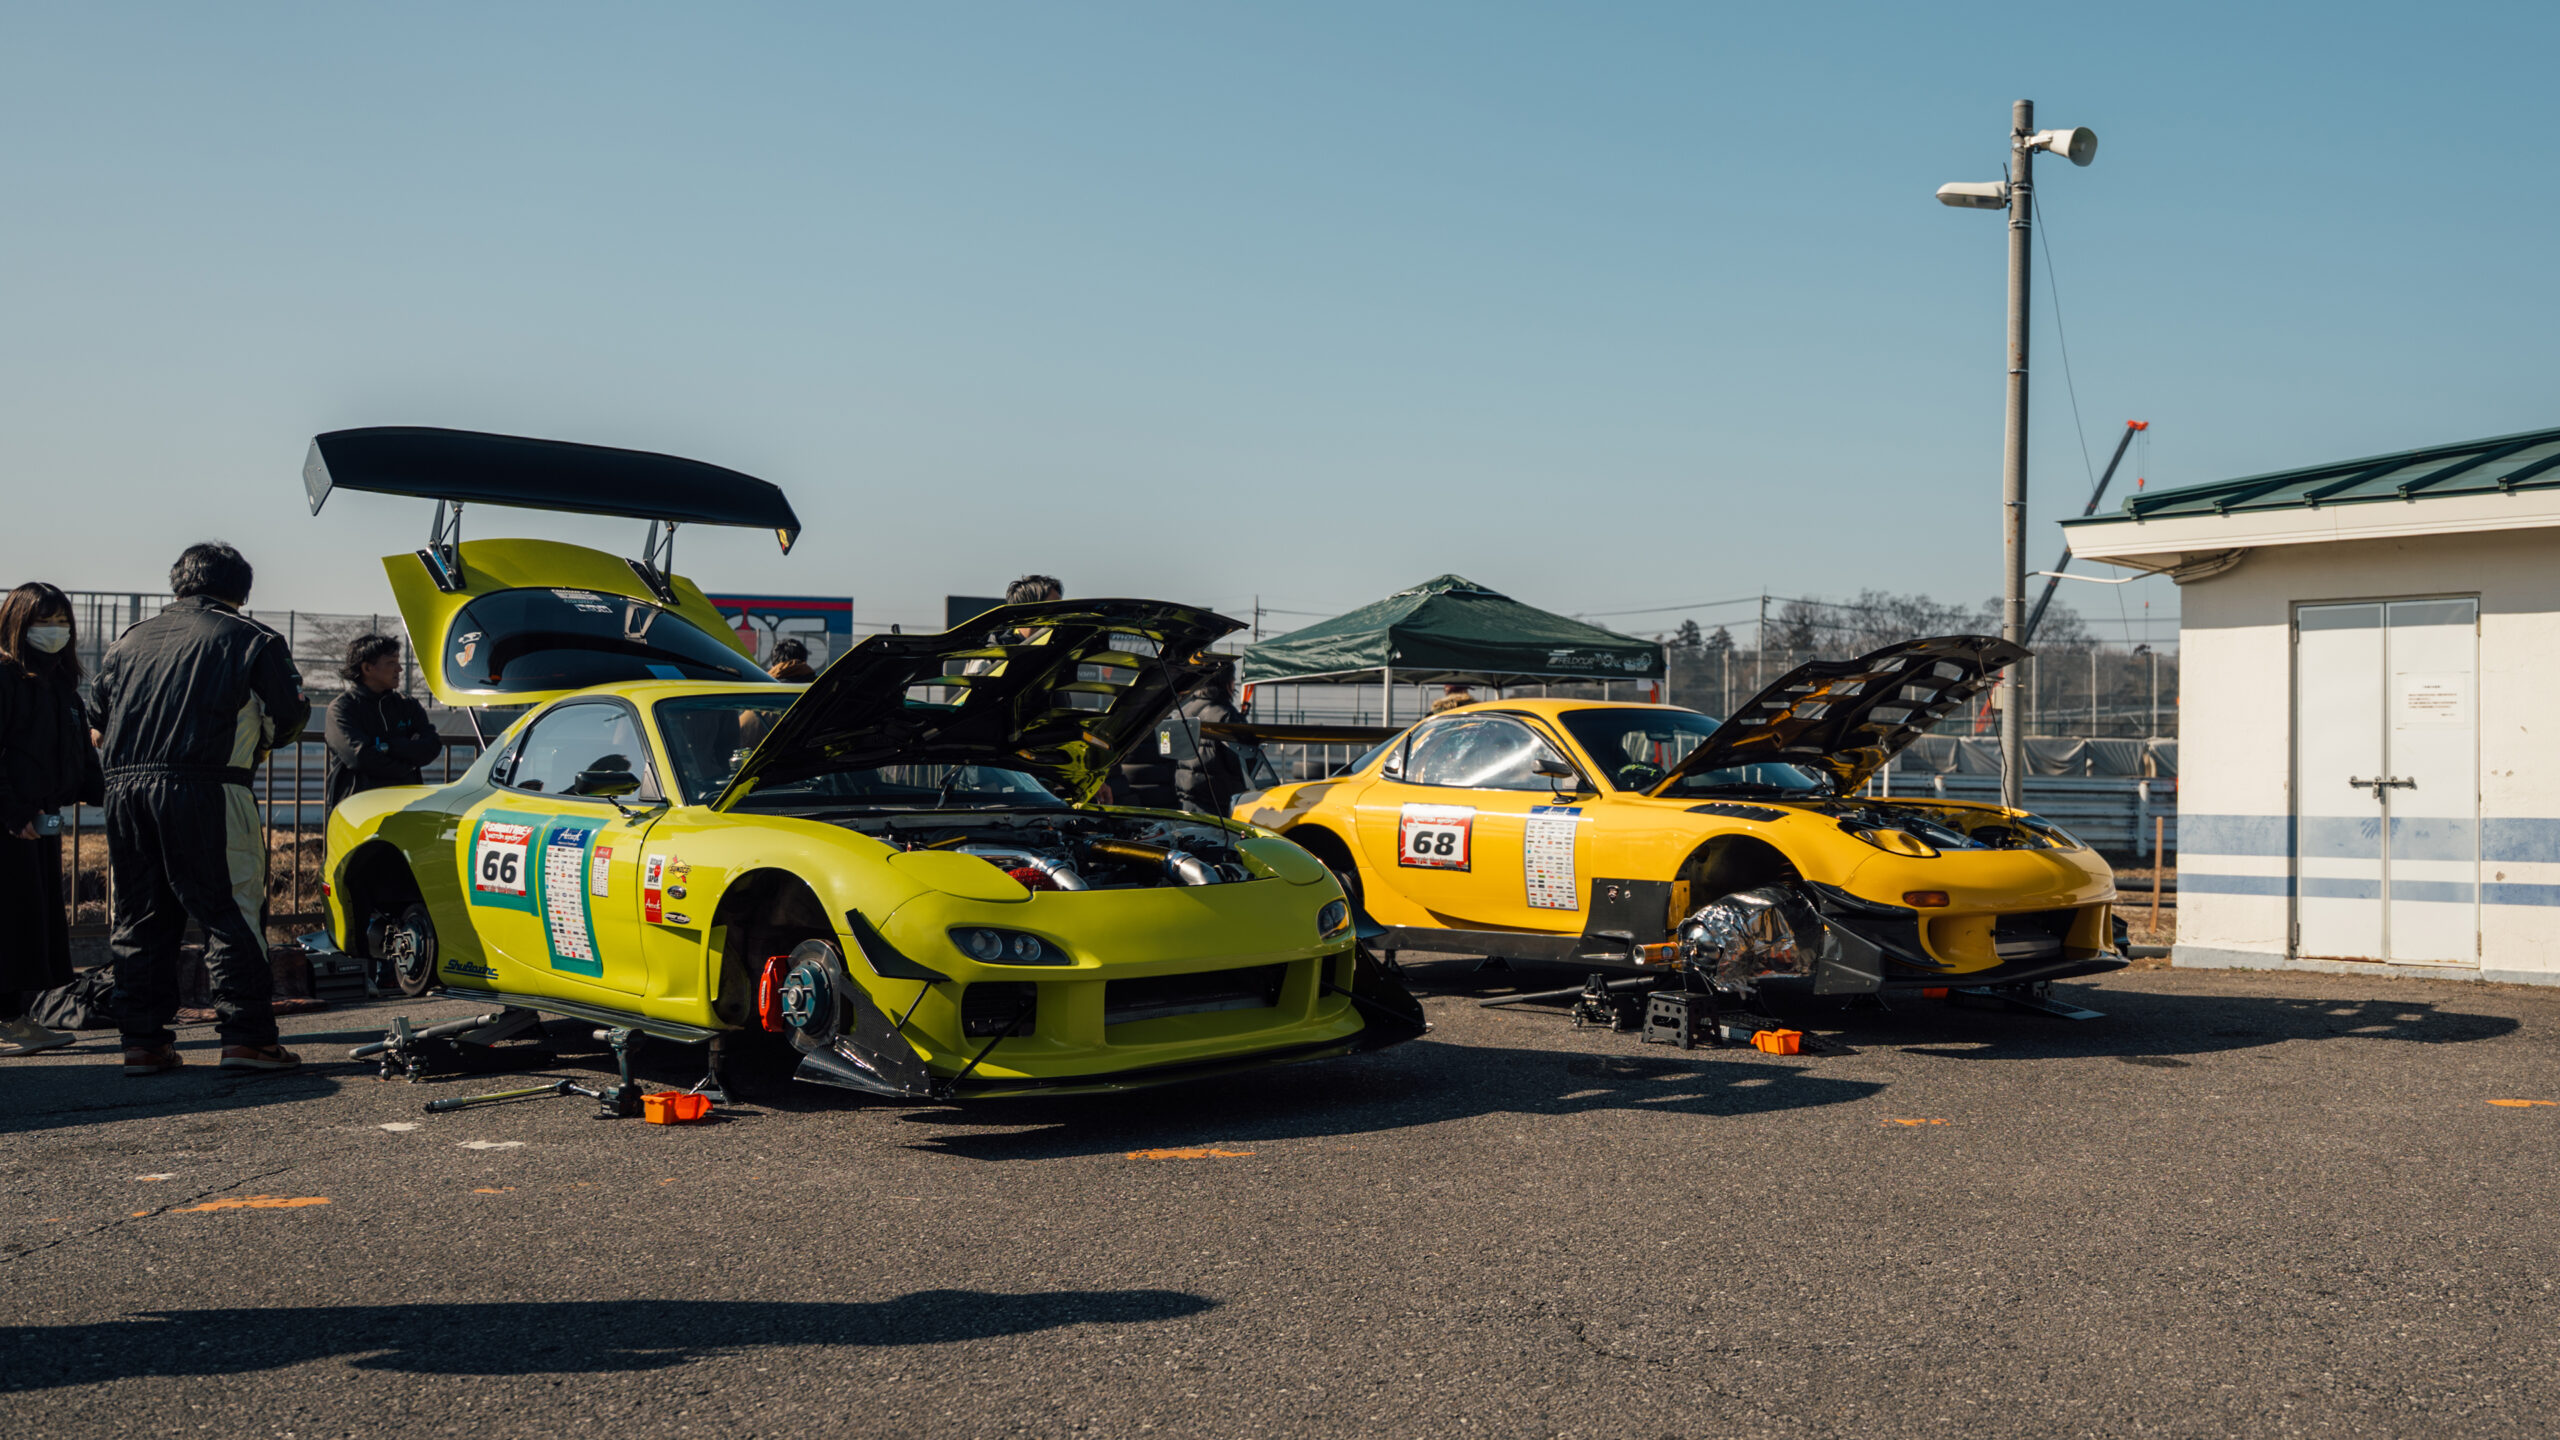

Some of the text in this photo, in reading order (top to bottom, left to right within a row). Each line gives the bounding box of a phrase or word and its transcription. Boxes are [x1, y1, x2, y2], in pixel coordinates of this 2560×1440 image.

[1412, 830, 1457, 856] 68
[482, 850, 519, 884] 66
[668, 864, 692, 875] SUNOCO
